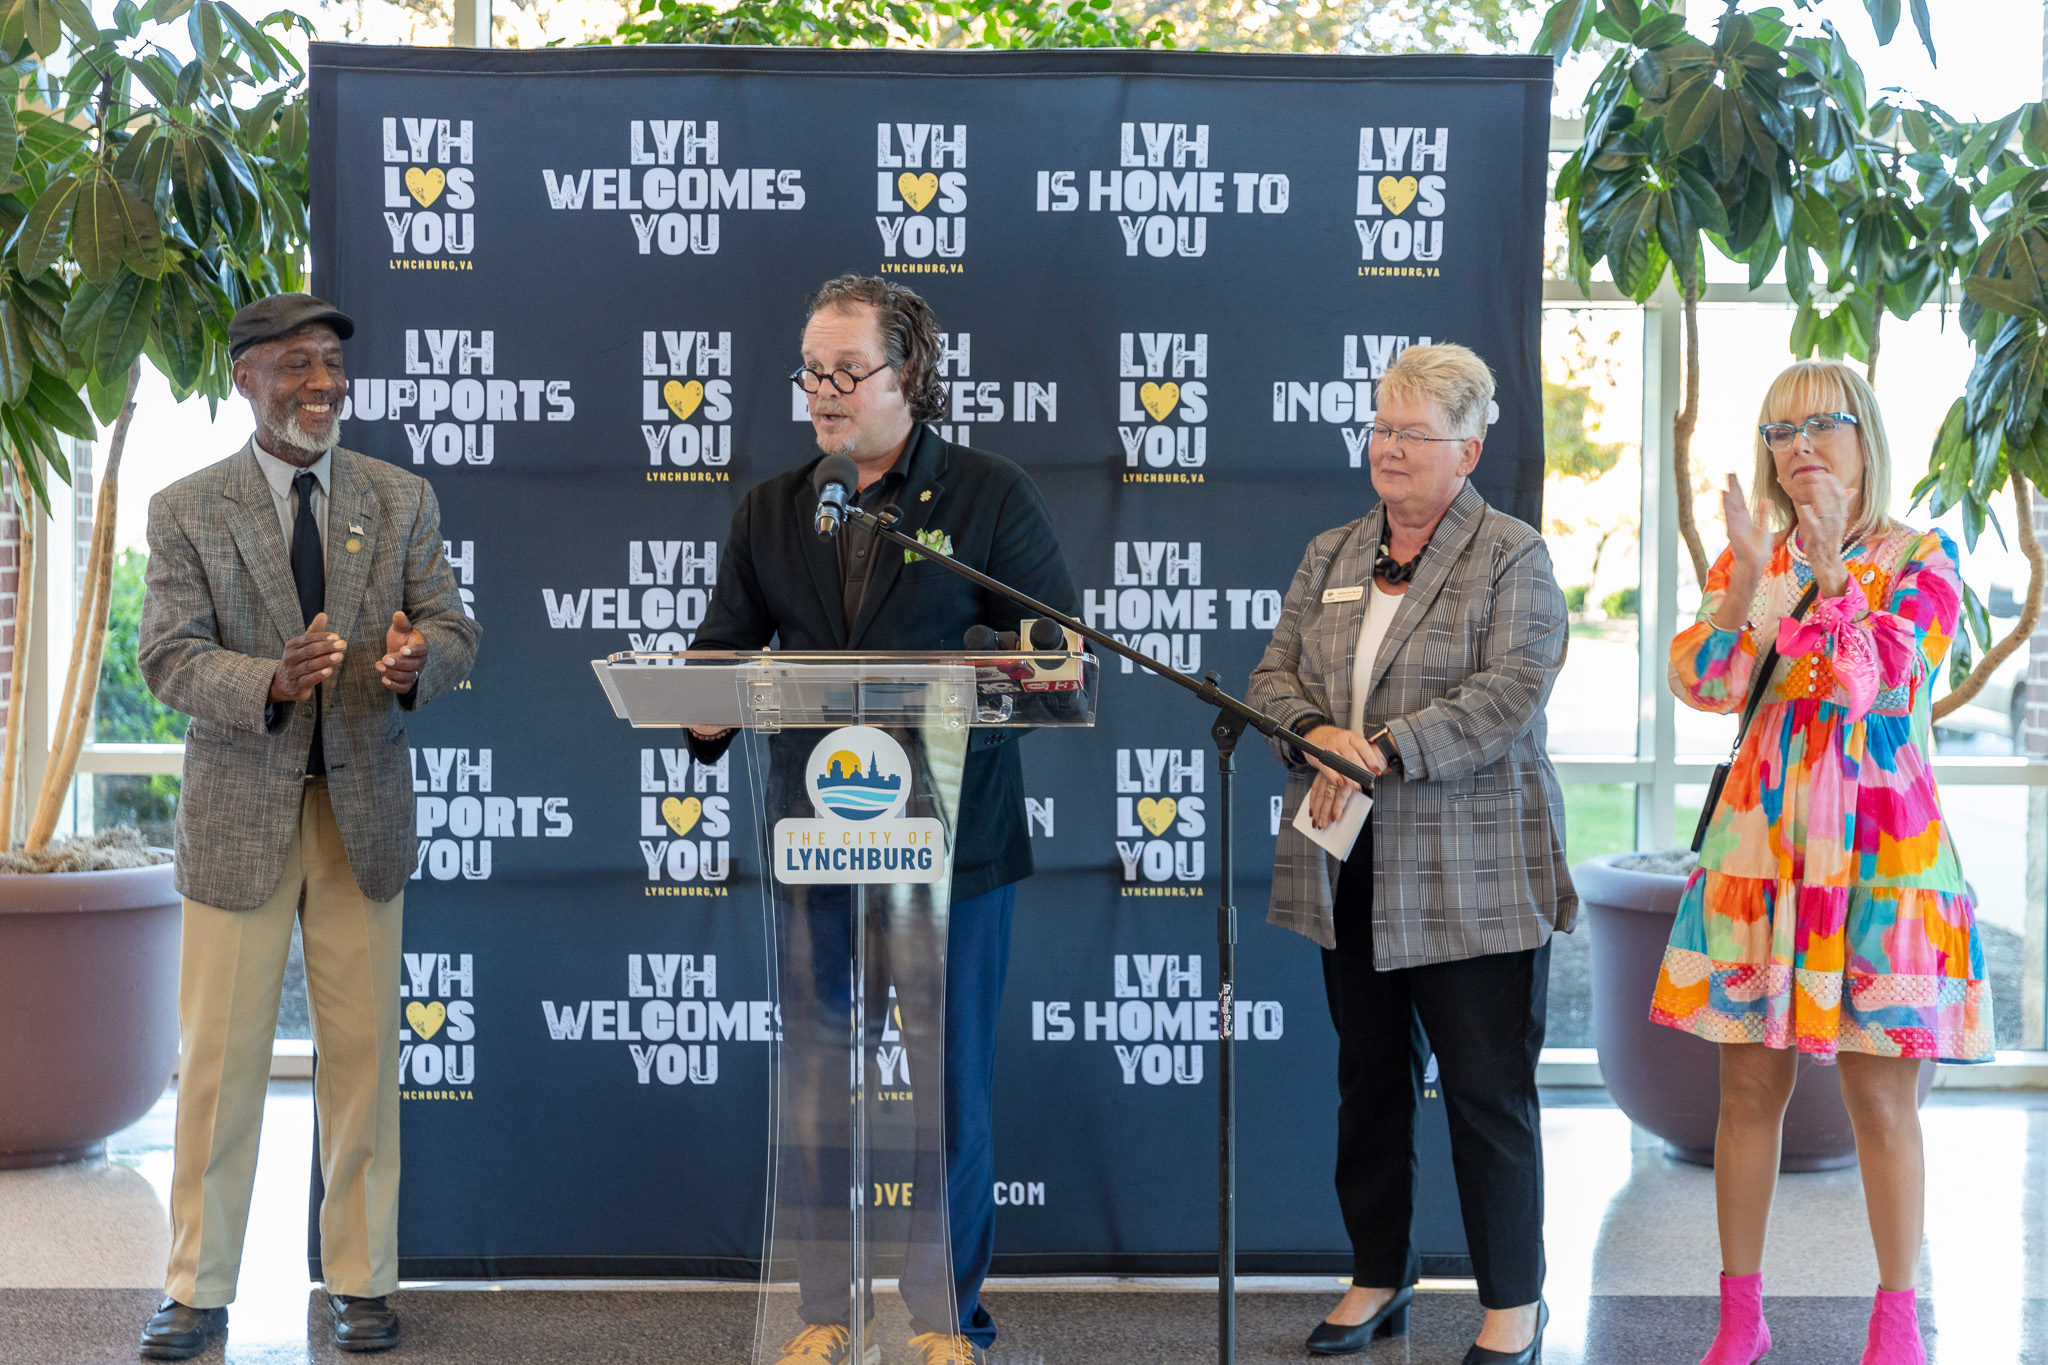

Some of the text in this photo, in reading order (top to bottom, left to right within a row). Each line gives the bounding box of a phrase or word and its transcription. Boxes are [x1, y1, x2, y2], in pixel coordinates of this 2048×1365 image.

[383, 117, 473, 164] LYH
[631, 120, 718, 165] LYH
[878, 123, 966, 168] LYH
[1121, 123, 1209, 168] LYH
[1358, 127, 1448, 171] LYH
[542, 168, 805, 210] WELCOMES
[1037, 170, 1289, 213] IS HOME TO
[384, 211, 474, 254] YOU
[630, 213, 719, 255] YOU
[876, 216, 965, 258] YOU
[1118, 215, 1206, 257] YOU
[1354, 219, 1443, 261] YOU
[406, 330, 494, 375] LYH
[643, 331, 731, 376] LYH
[1120, 333, 1207, 377] LYH
[1014, 382, 1056, 422] IN
[404, 423, 494, 465] YOU
[642, 424, 731, 466] YOU
[1118, 425, 1206, 467] YOU
[629, 541, 717, 585] LYH
[1115, 542, 1201, 585] LYH
[542, 588, 713, 629] WELCO
[1083, 588, 1282, 630] HOME TO
[627, 631, 697, 666] YO
[1113, 632, 1202, 675] YOU
[408, 747, 493, 793] LYH
[641, 749, 729, 792] LYH
[1117, 749, 1204, 792] LYH
[417, 796, 572, 840] PORTS
[787, 831, 933, 846] THE CITY OF
[639, 840, 729, 881] YOU
[786, 847, 933, 871] LYNCHBURG
[1116, 840, 1204, 881] YOU
[629, 954, 716, 997] LYH
[1115, 955, 1201, 997] LYH
[1033, 1001, 1283, 1041] IS HOME TO
[629, 1044, 718, 1084] YOU
[1115, 1044, 1203, 1084] YOU
